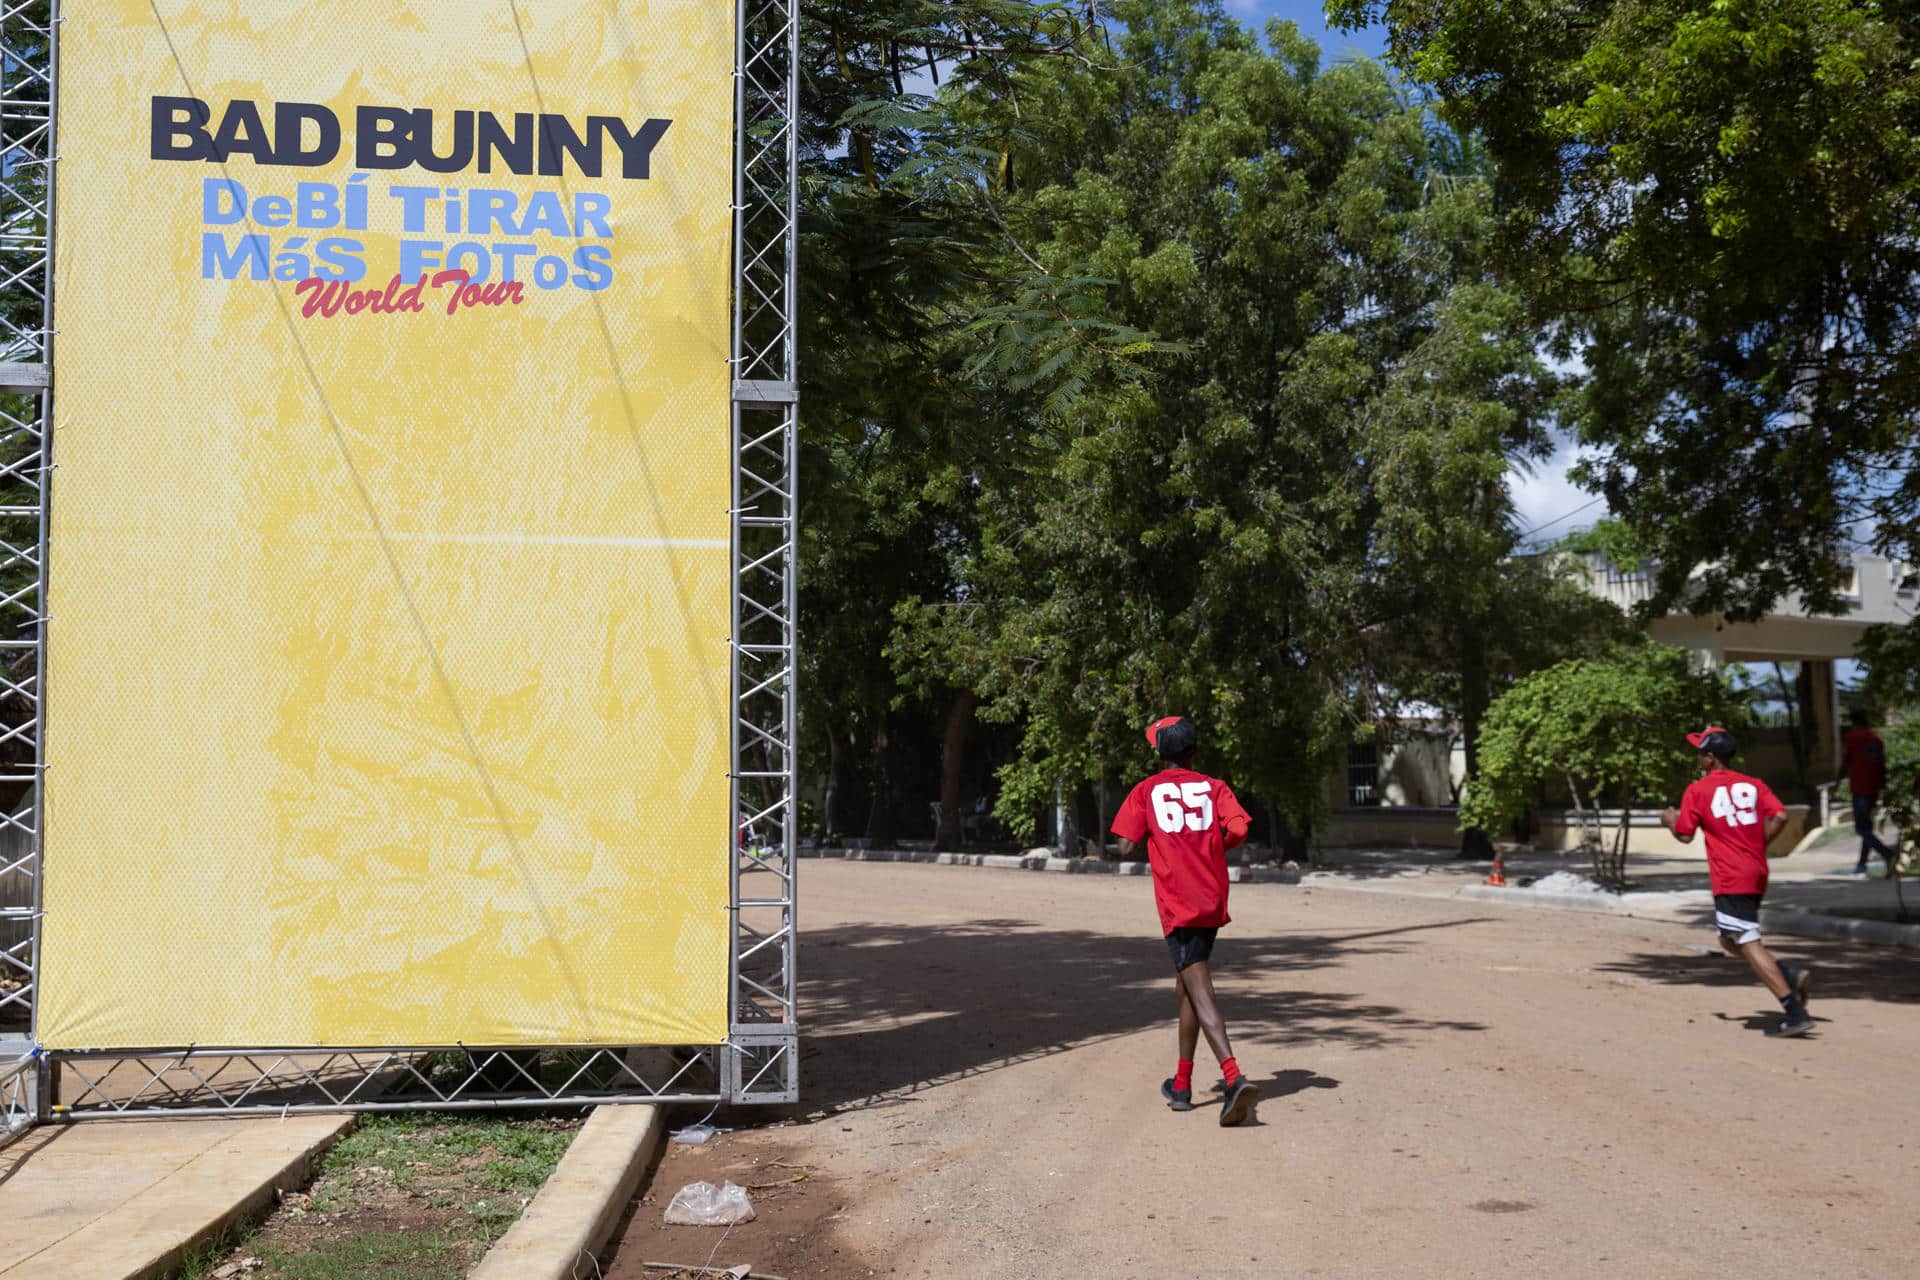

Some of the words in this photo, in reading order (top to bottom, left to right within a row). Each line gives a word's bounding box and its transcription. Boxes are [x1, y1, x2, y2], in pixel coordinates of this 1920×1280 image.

[151, 96, 341, 167] BAD
[356, 105, 673, 179] BUNNY
[202, 173, 368, 230] DeBÍ
[389, 185, 613, 238] TiRAR
[296, 273, 425, 318] World
[431, 269, 524, 315] Tour
[1151, 781, 1213, 833] 65
[1711, 782, 1758, 827] 49
